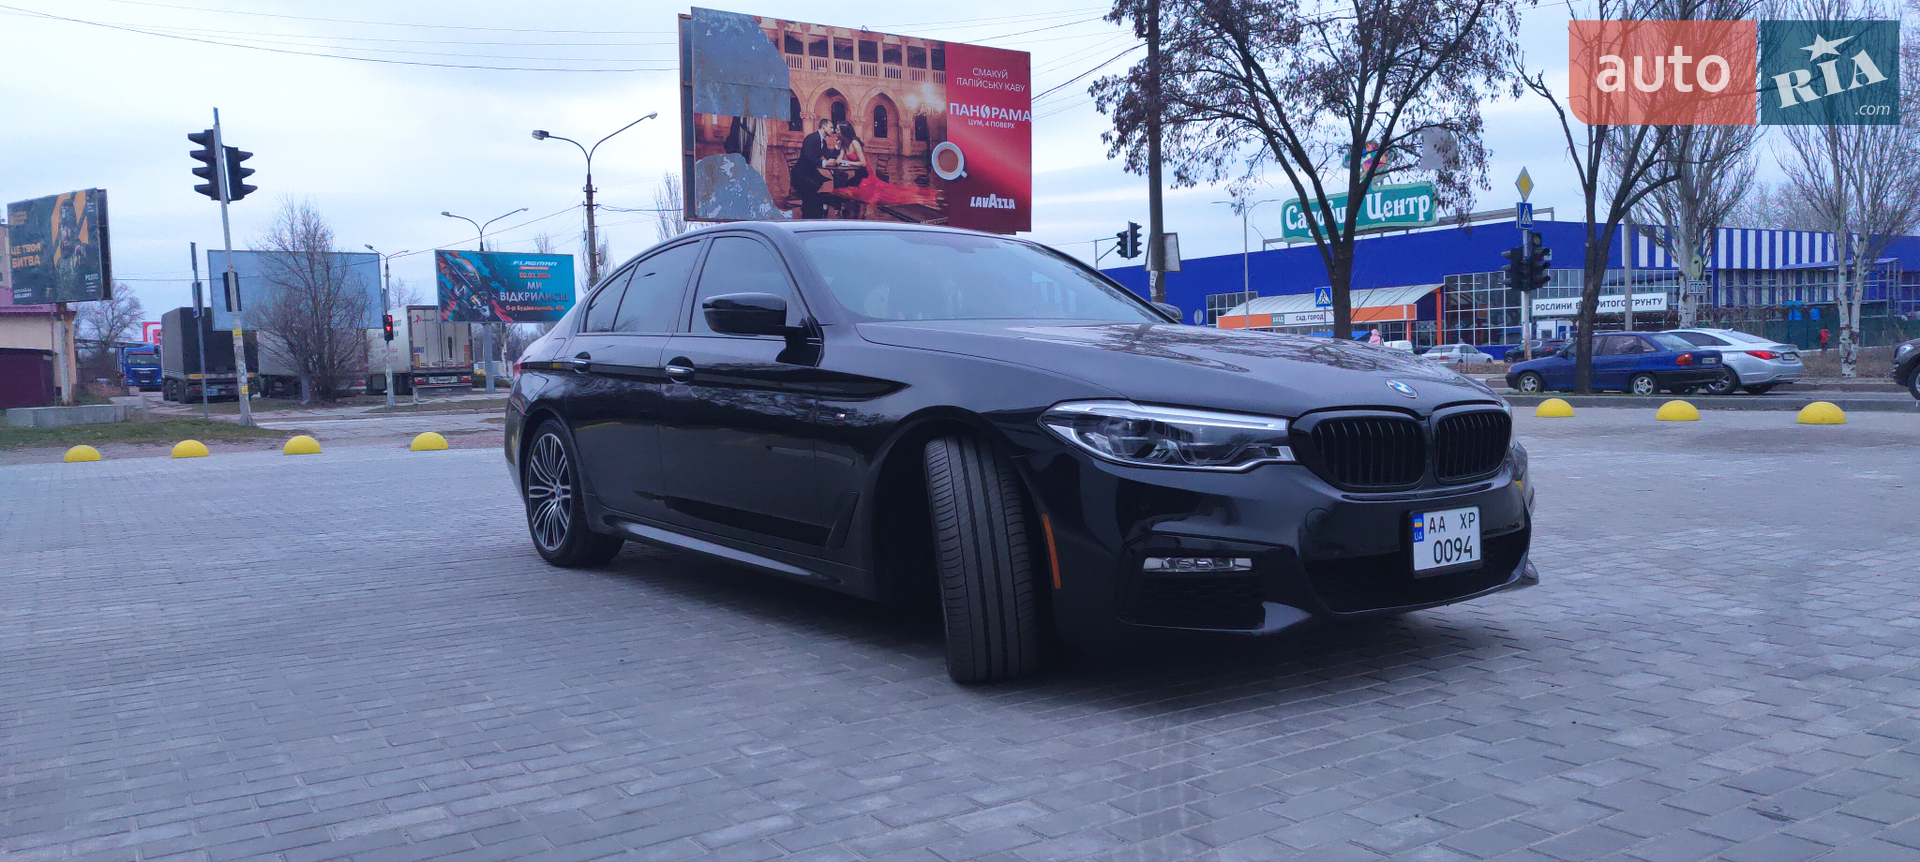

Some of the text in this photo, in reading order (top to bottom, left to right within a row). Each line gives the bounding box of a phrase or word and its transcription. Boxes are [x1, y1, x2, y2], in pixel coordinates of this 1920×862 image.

[972, 67, 1008, 79] СМАКУЙ
[956, 77, 1026, 93] ІТАЛІЙСЬКУ КАВУ
[949, 103, 1031, 122] ПАНОРАМА
[990, 121, 1016, 129] ПОВЕРХ
[970, 193, 1016, 209] LAVAZZA
[1366, 192, 1430, 221] Центр
[11, 243, 41, 255] ЦЕ ТВОЯ
[12, 255, 41, 268] БИТВА
[527, 281, 542, 289] МИ
[1535, 302, 1572, 311] РОСЛИНИ
[1429, 512, 1476, 534] AA XP
[1414, 531, 1423, 541] UA
[1433, 535, 1473, 564] 0094
